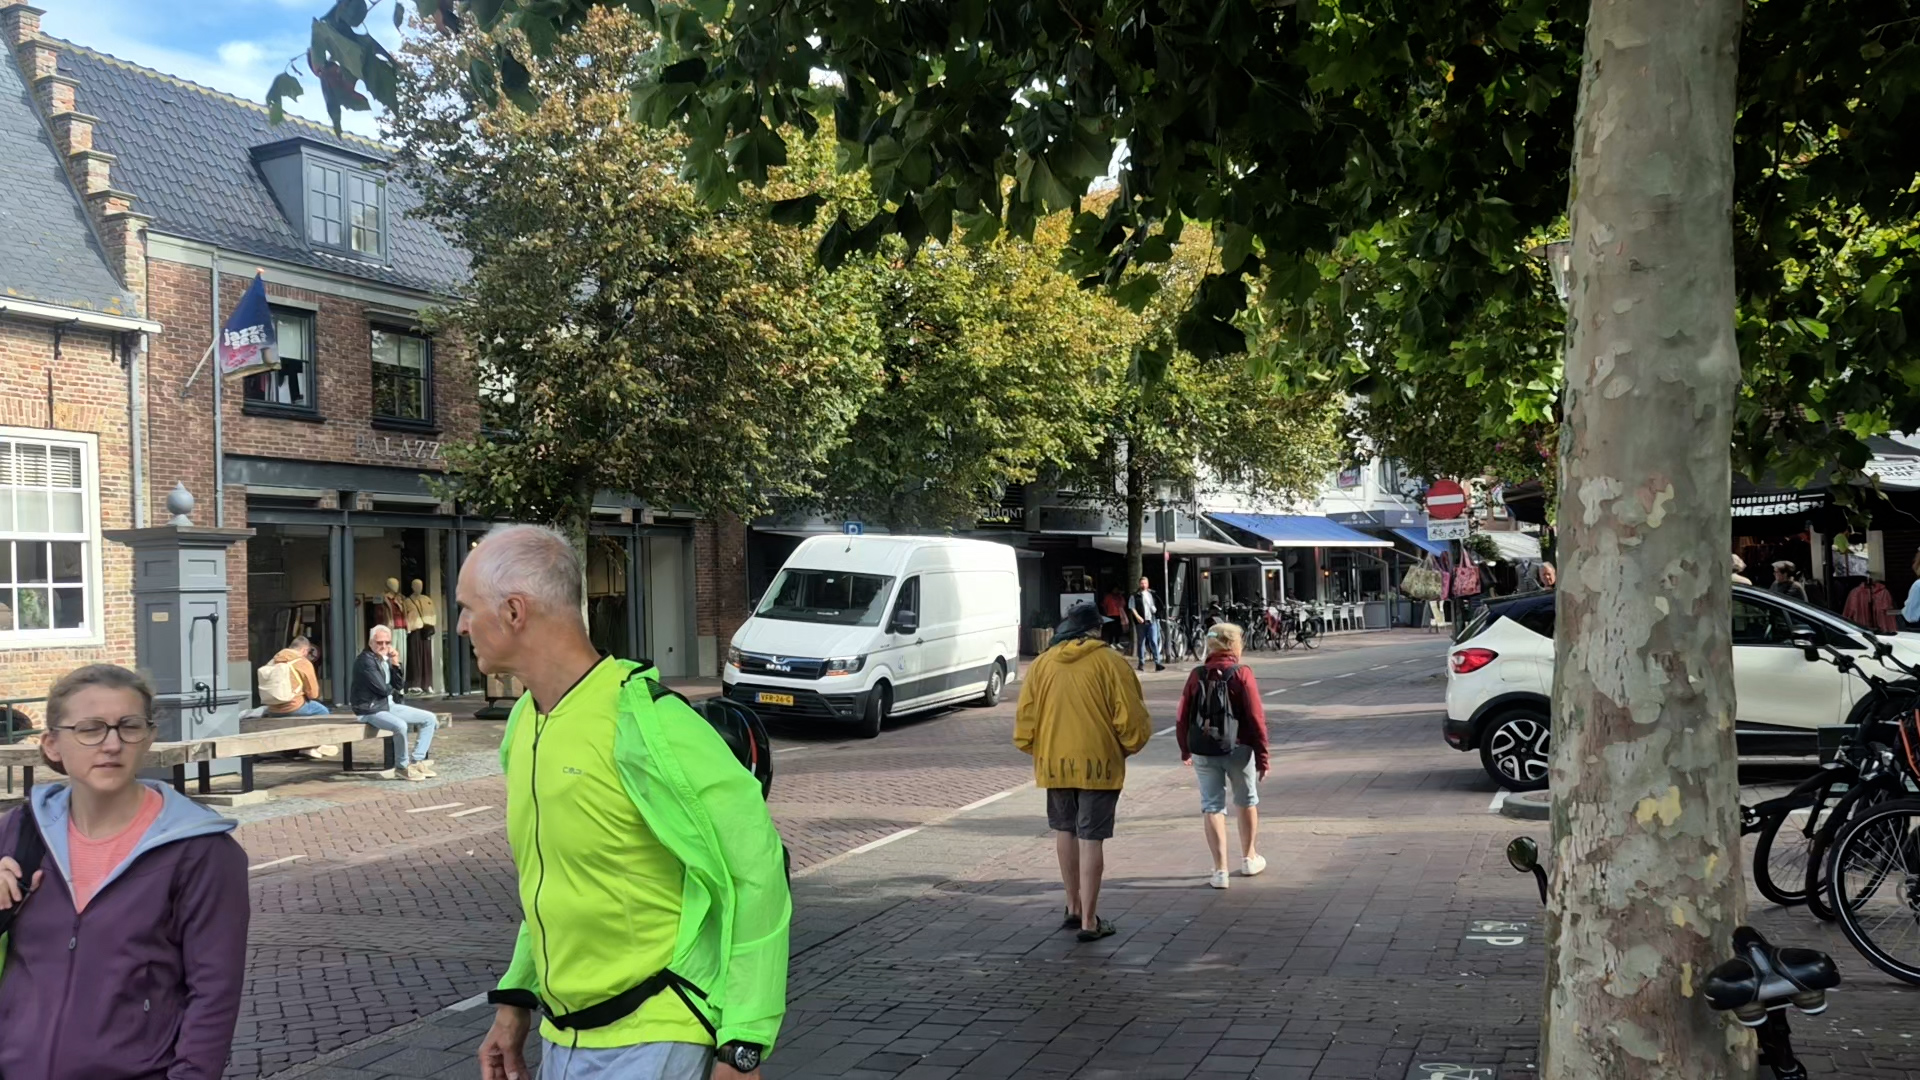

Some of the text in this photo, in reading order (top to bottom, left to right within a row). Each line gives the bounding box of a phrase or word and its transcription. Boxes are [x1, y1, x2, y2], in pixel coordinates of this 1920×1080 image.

[356, 435, 441, 460] PALAZZ
[1732, 493, 1797, 505] IERBROUWERIJ
[765, 663, 791, 673] MAN
[1086, 758, 1111, 780] DOG
